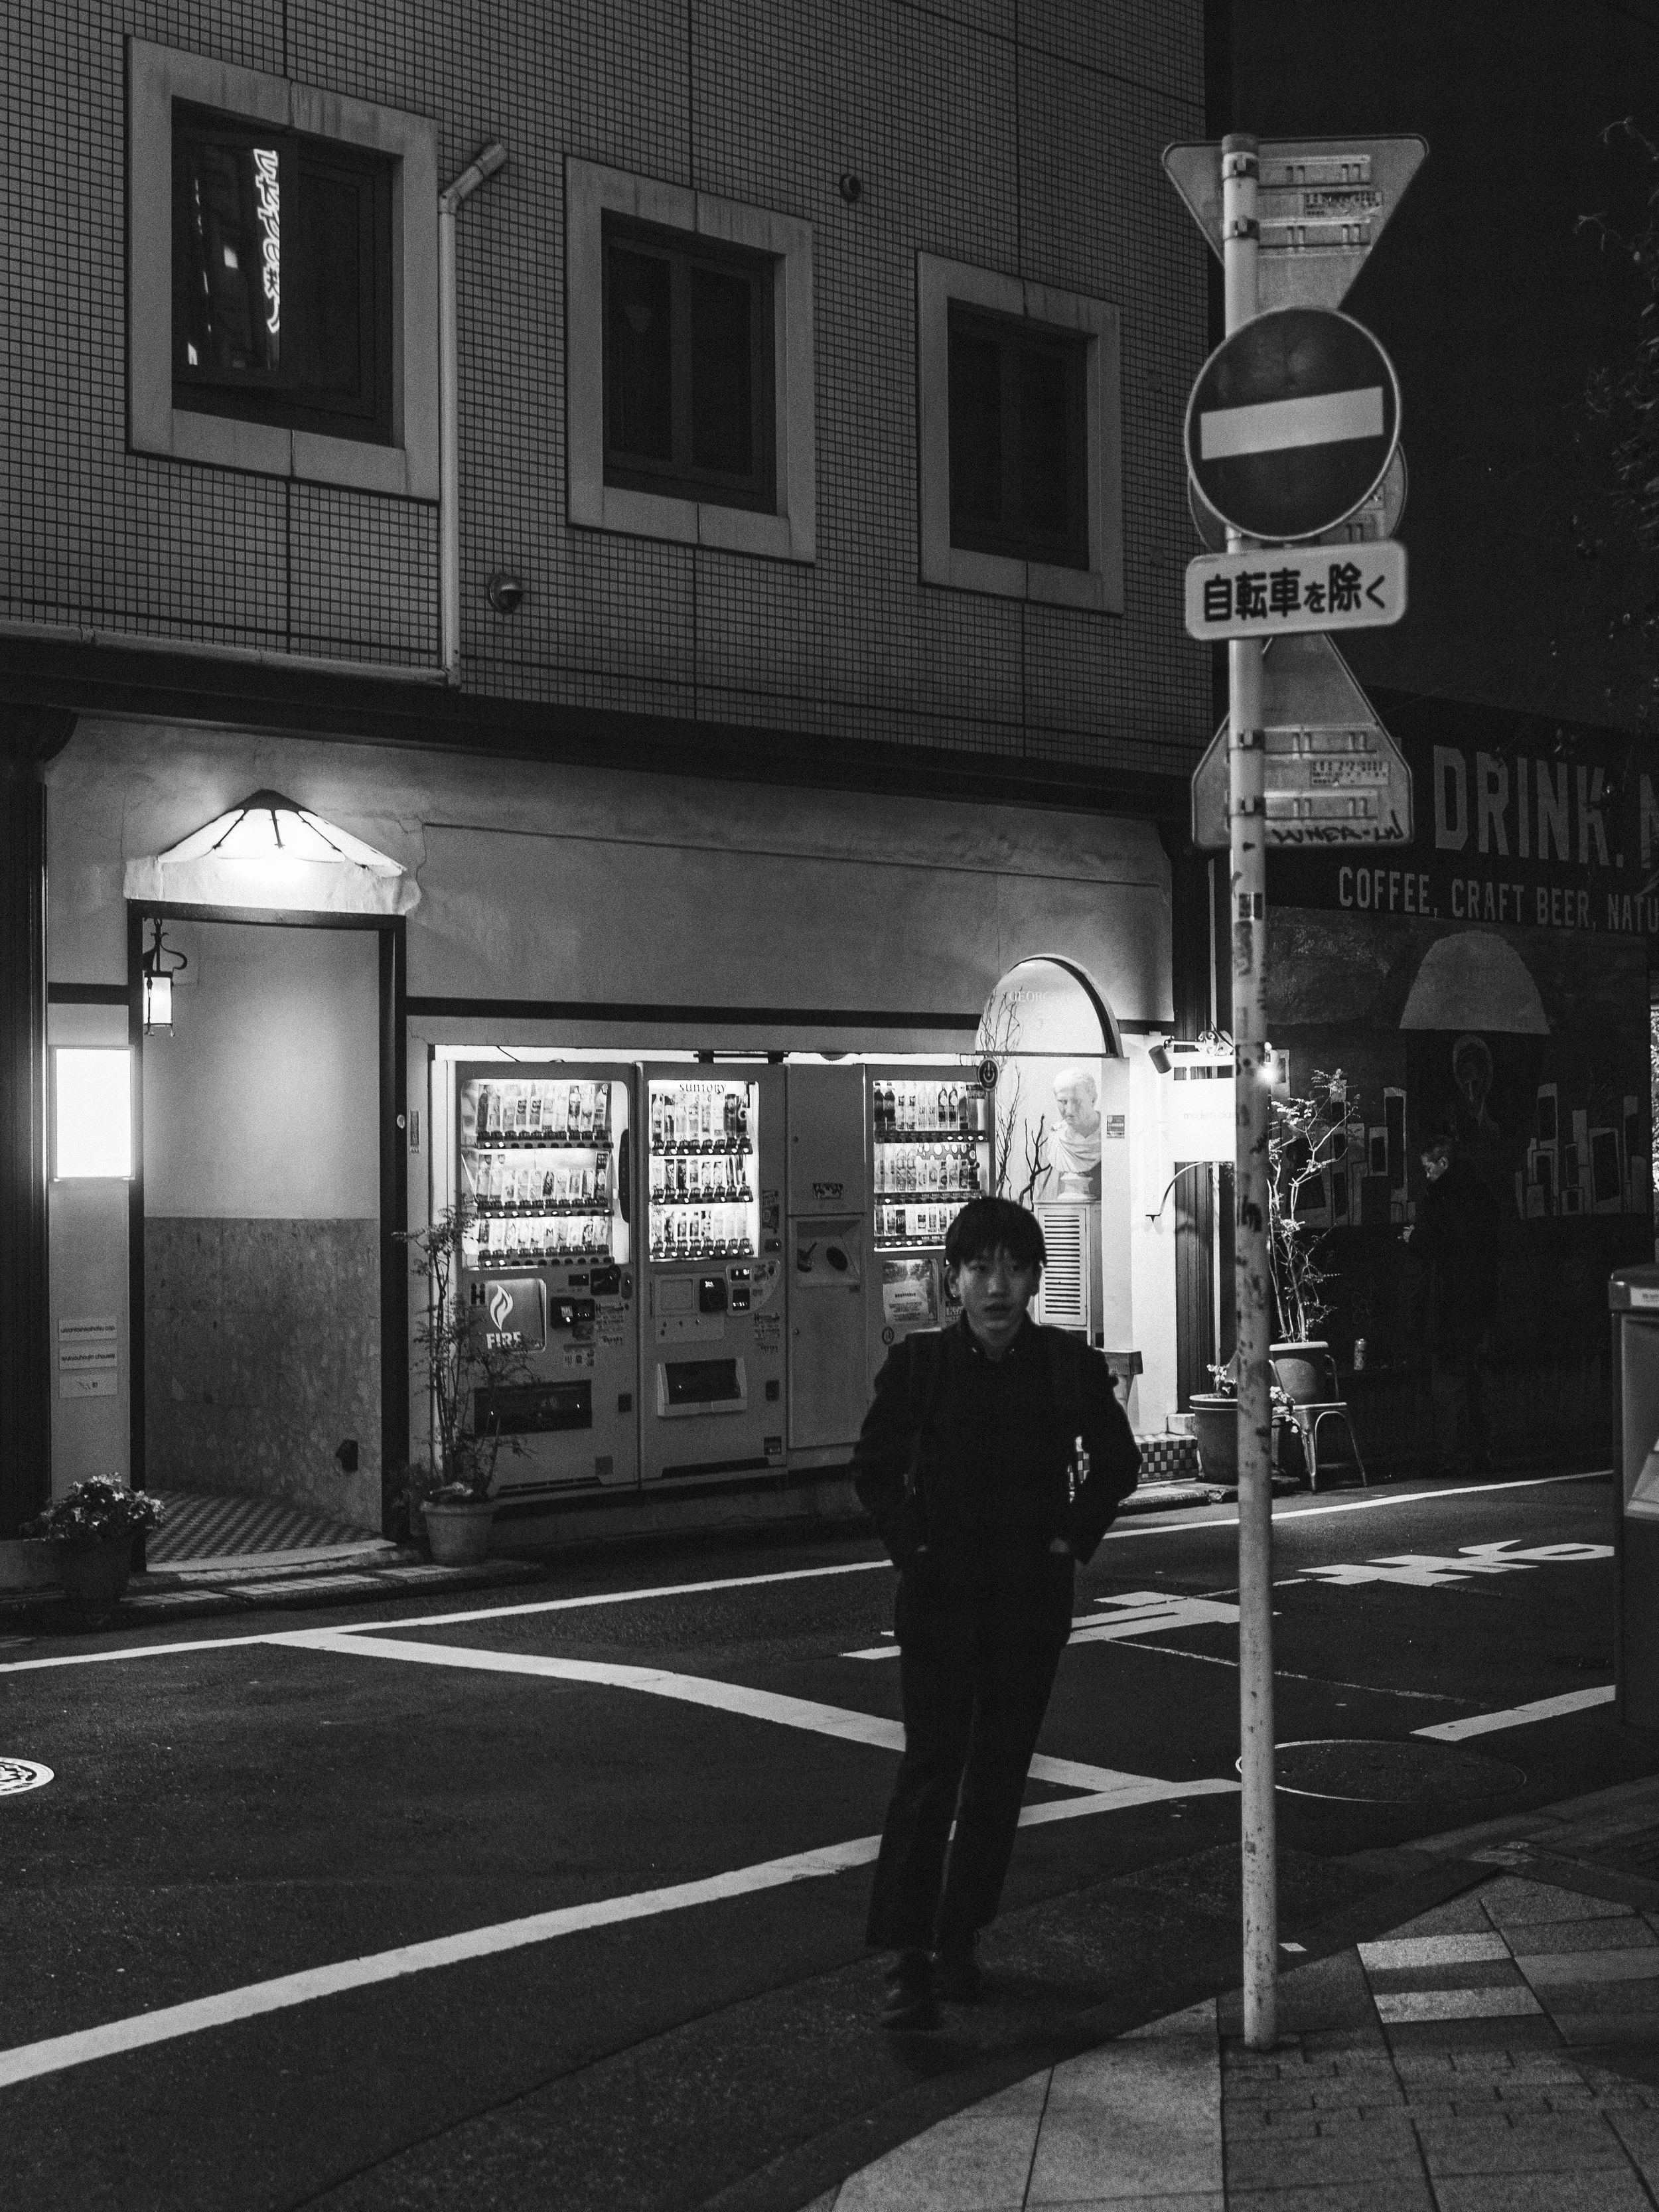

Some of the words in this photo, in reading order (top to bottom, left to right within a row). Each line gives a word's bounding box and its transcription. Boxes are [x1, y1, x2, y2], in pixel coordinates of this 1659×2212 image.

[1204, 561, 1386, 623] 自転車を除く
[1433, 745, 1624, 868] DRINK.
[1338, 865, 1439, 919] COFFEE,
[1452, 879, 1524, 923] CRAFT
[1536, 887, 1597, 932] BEER,
[486, 1331, 523, 1350] FIRE
